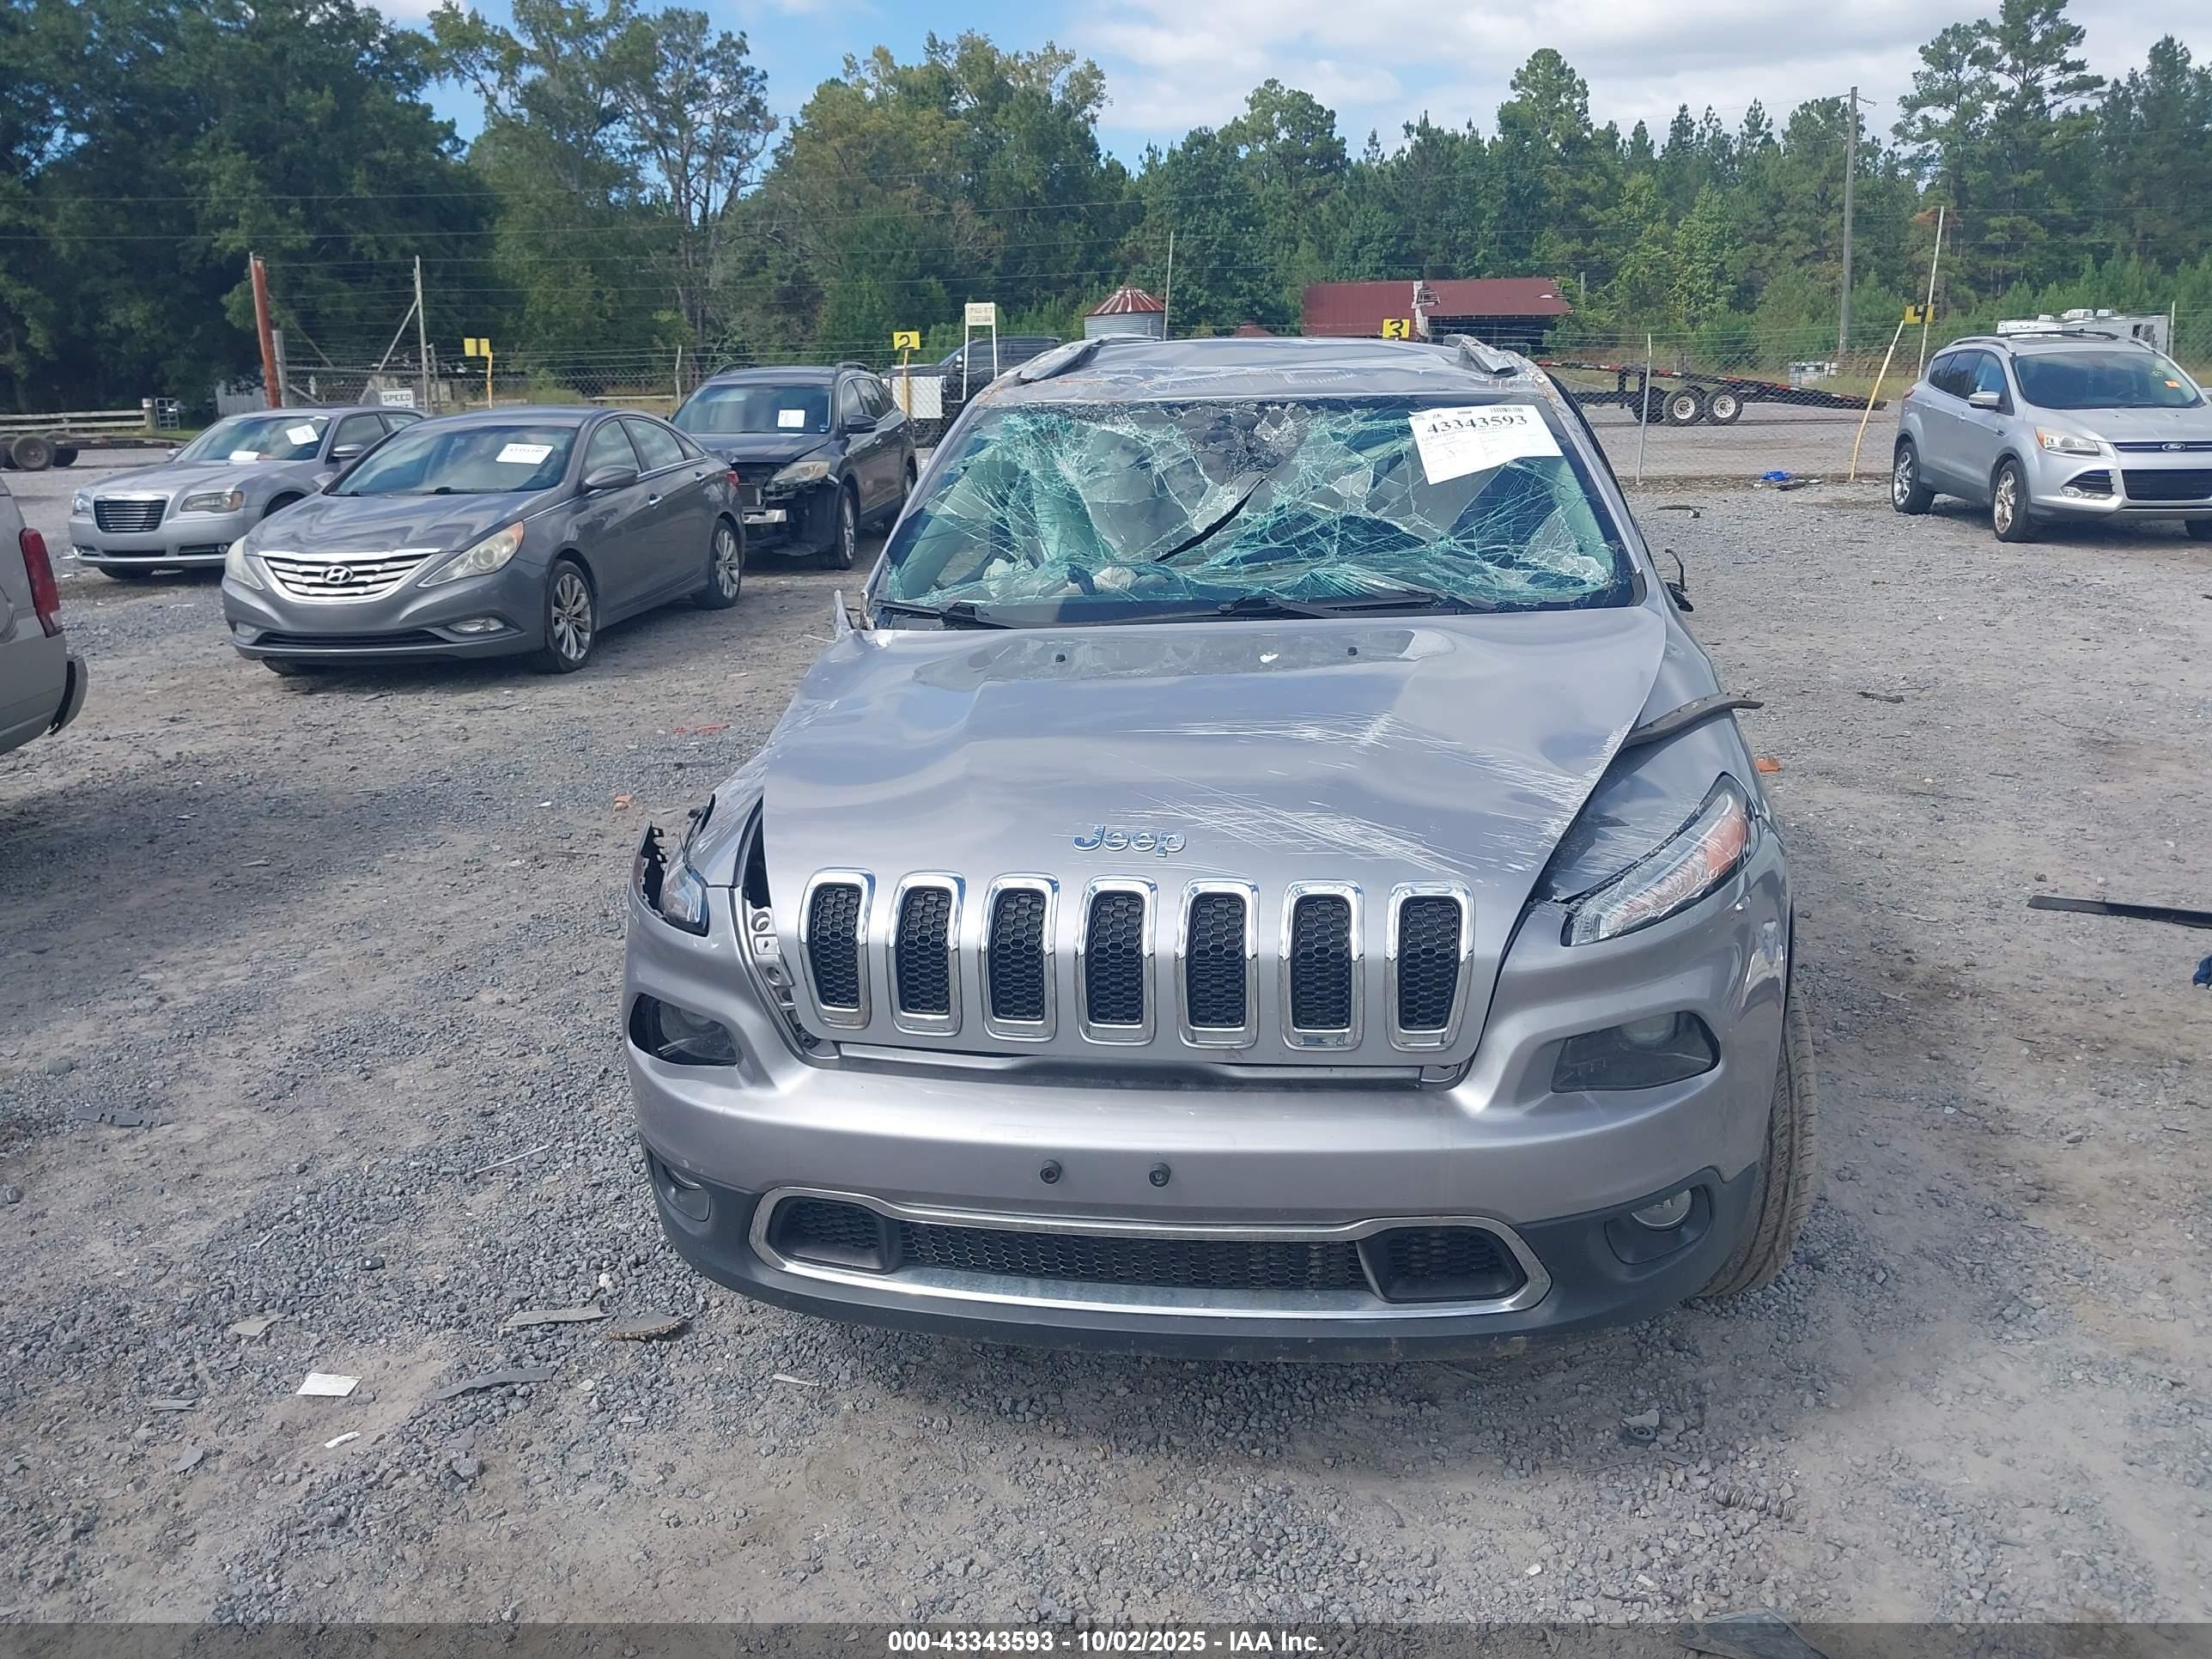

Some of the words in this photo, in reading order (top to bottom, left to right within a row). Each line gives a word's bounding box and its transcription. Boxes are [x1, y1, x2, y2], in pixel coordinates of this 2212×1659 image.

[1913, 304, 1928, 324] 4
[1389, 320, 1404, 337] 3
[897, 334, 915, 351] 2
[383, 394, 412, 403] SPEED
[1427, 415, 1528, 434] 43343593
[1073, 824, 1187, 858] Jeep
